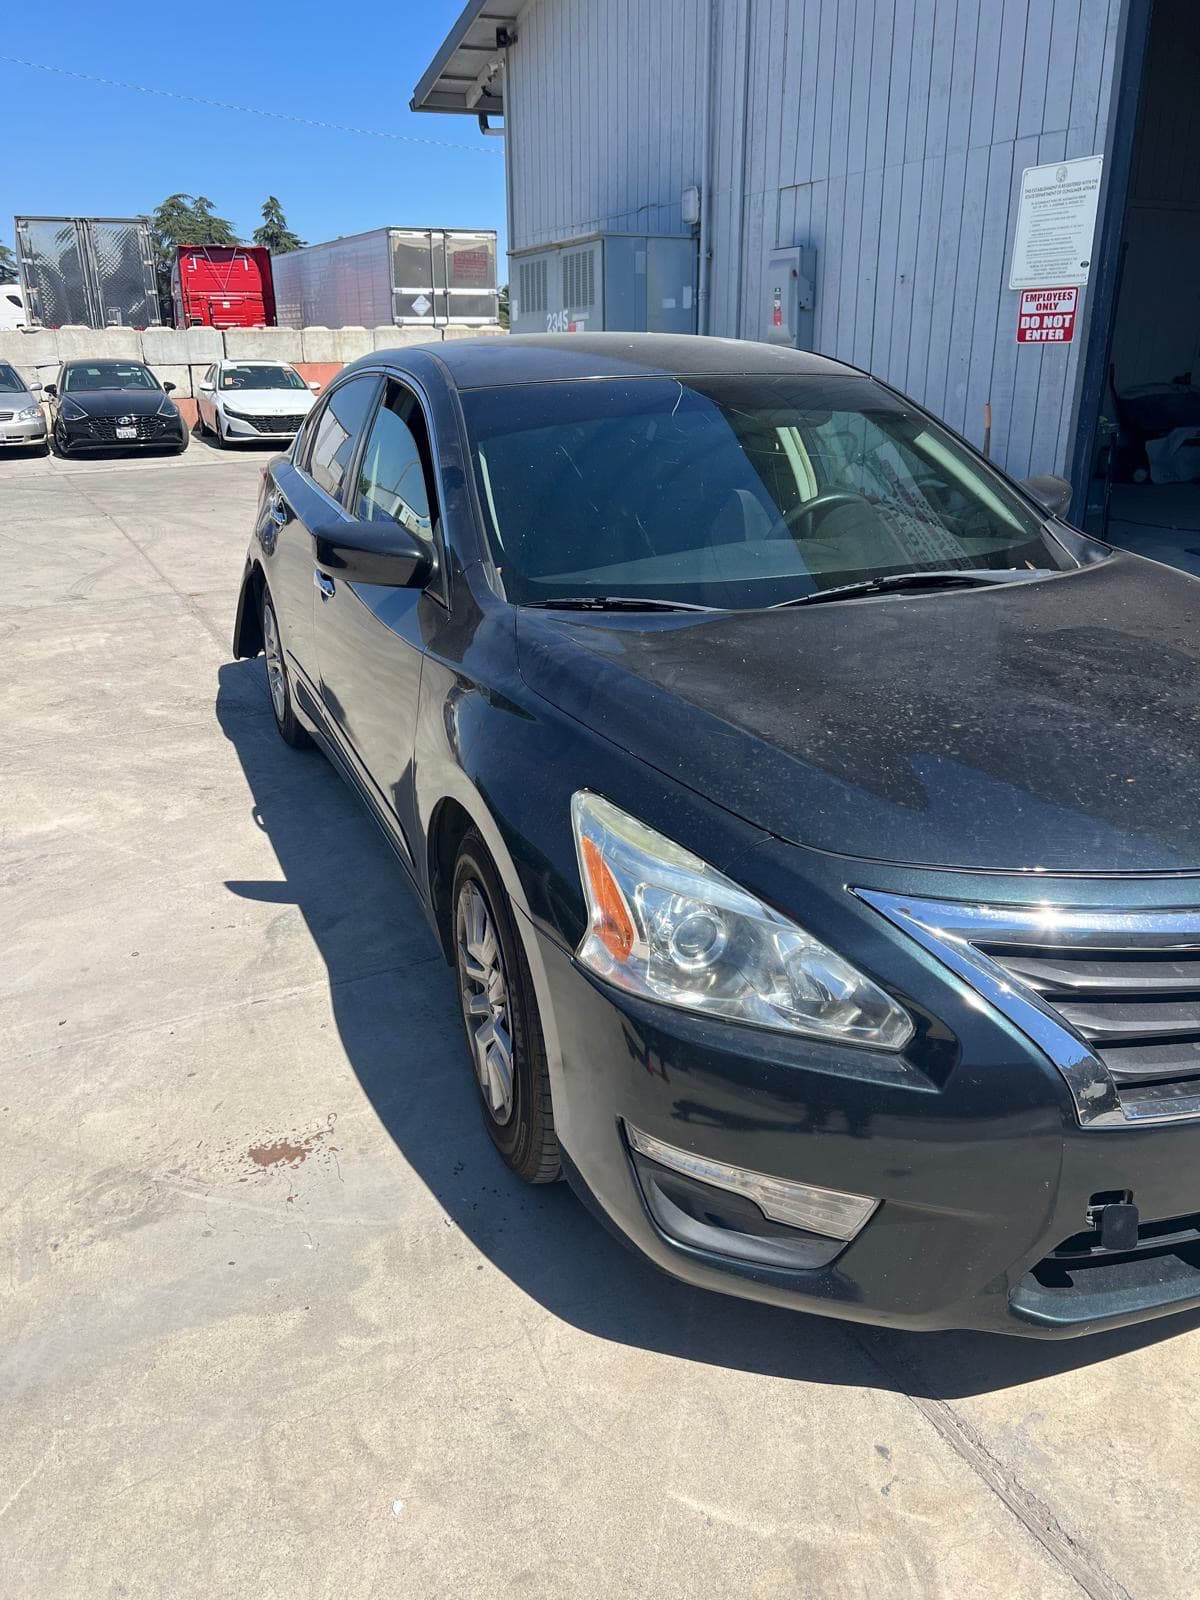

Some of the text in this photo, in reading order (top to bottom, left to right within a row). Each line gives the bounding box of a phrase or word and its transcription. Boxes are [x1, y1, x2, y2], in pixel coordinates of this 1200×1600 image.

[1025, 291, 1073, 303] EMPLOYEES
[1036, 302, 1059, 311] ONLY
[546, 309, 569, 332] 2345
[1020, 315, 1073, 329] DO NOT
[1025, 329, 1065, 341] ENTER
